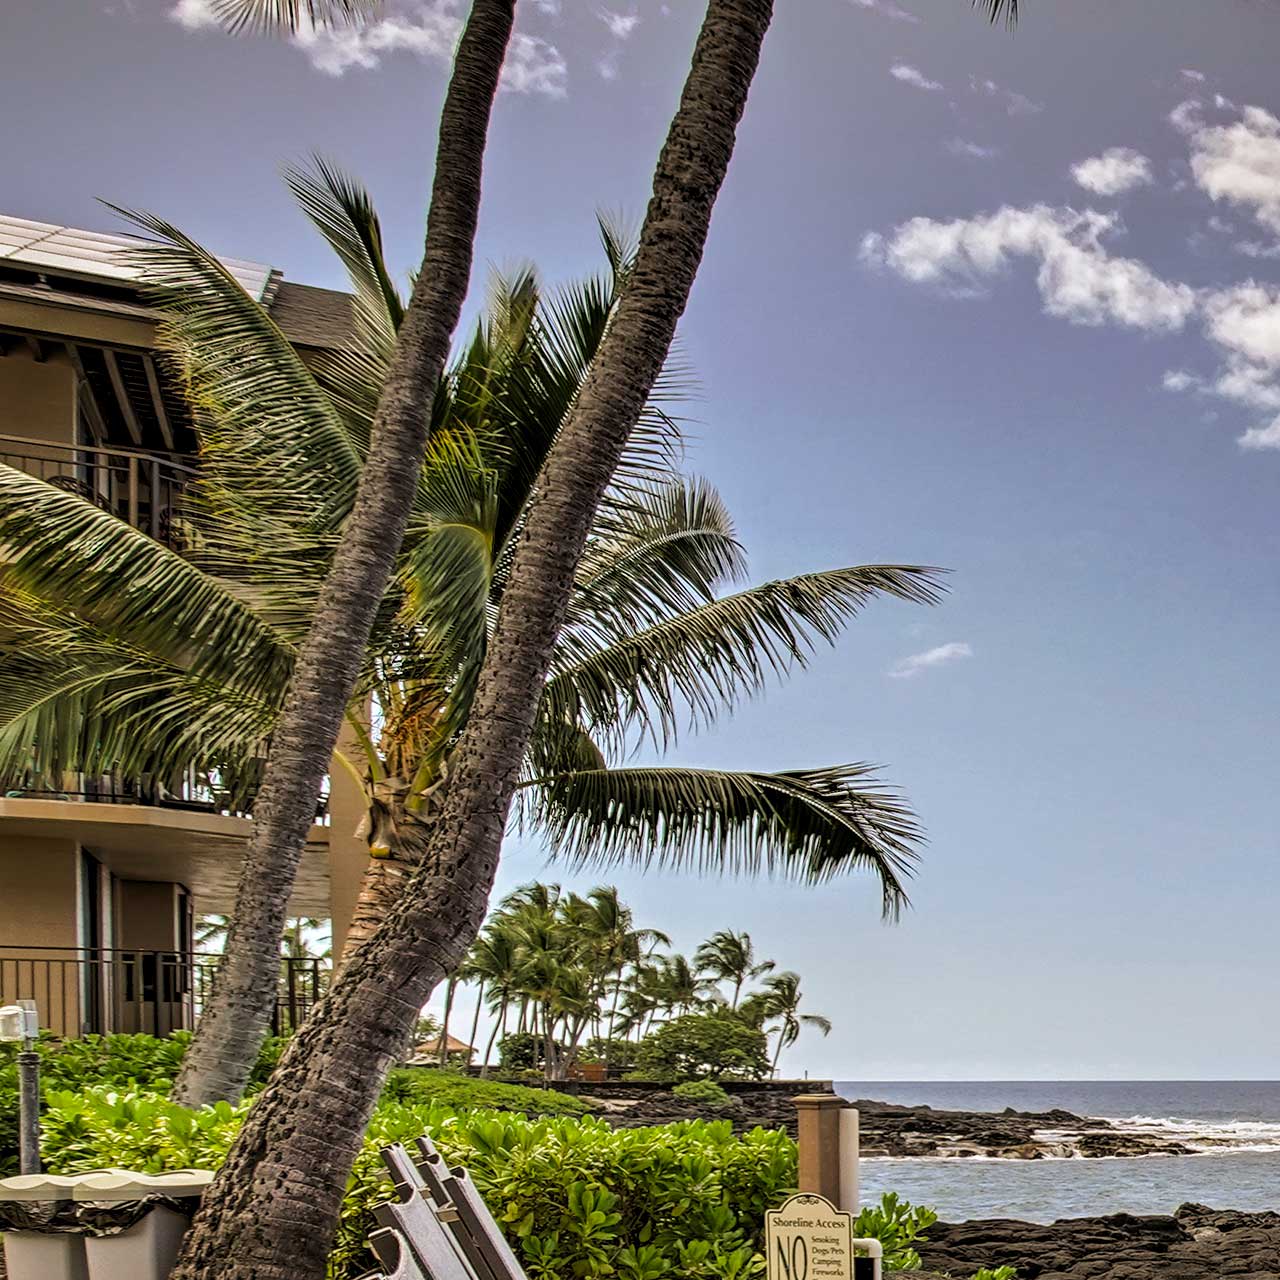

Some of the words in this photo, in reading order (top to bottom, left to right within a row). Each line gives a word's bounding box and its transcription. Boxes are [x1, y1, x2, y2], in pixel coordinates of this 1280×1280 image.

[773, 1217, 814, 1228] Shoreline
[815, 1219, 846, 1229] Access
[811, 1236, 840, 1245] Smoking
[812, 1247, 845, 1256] Dogs/Pets
[812, 1257, 842, 1266] Camping
[812, 1268, 845, 1276] Fireworks
